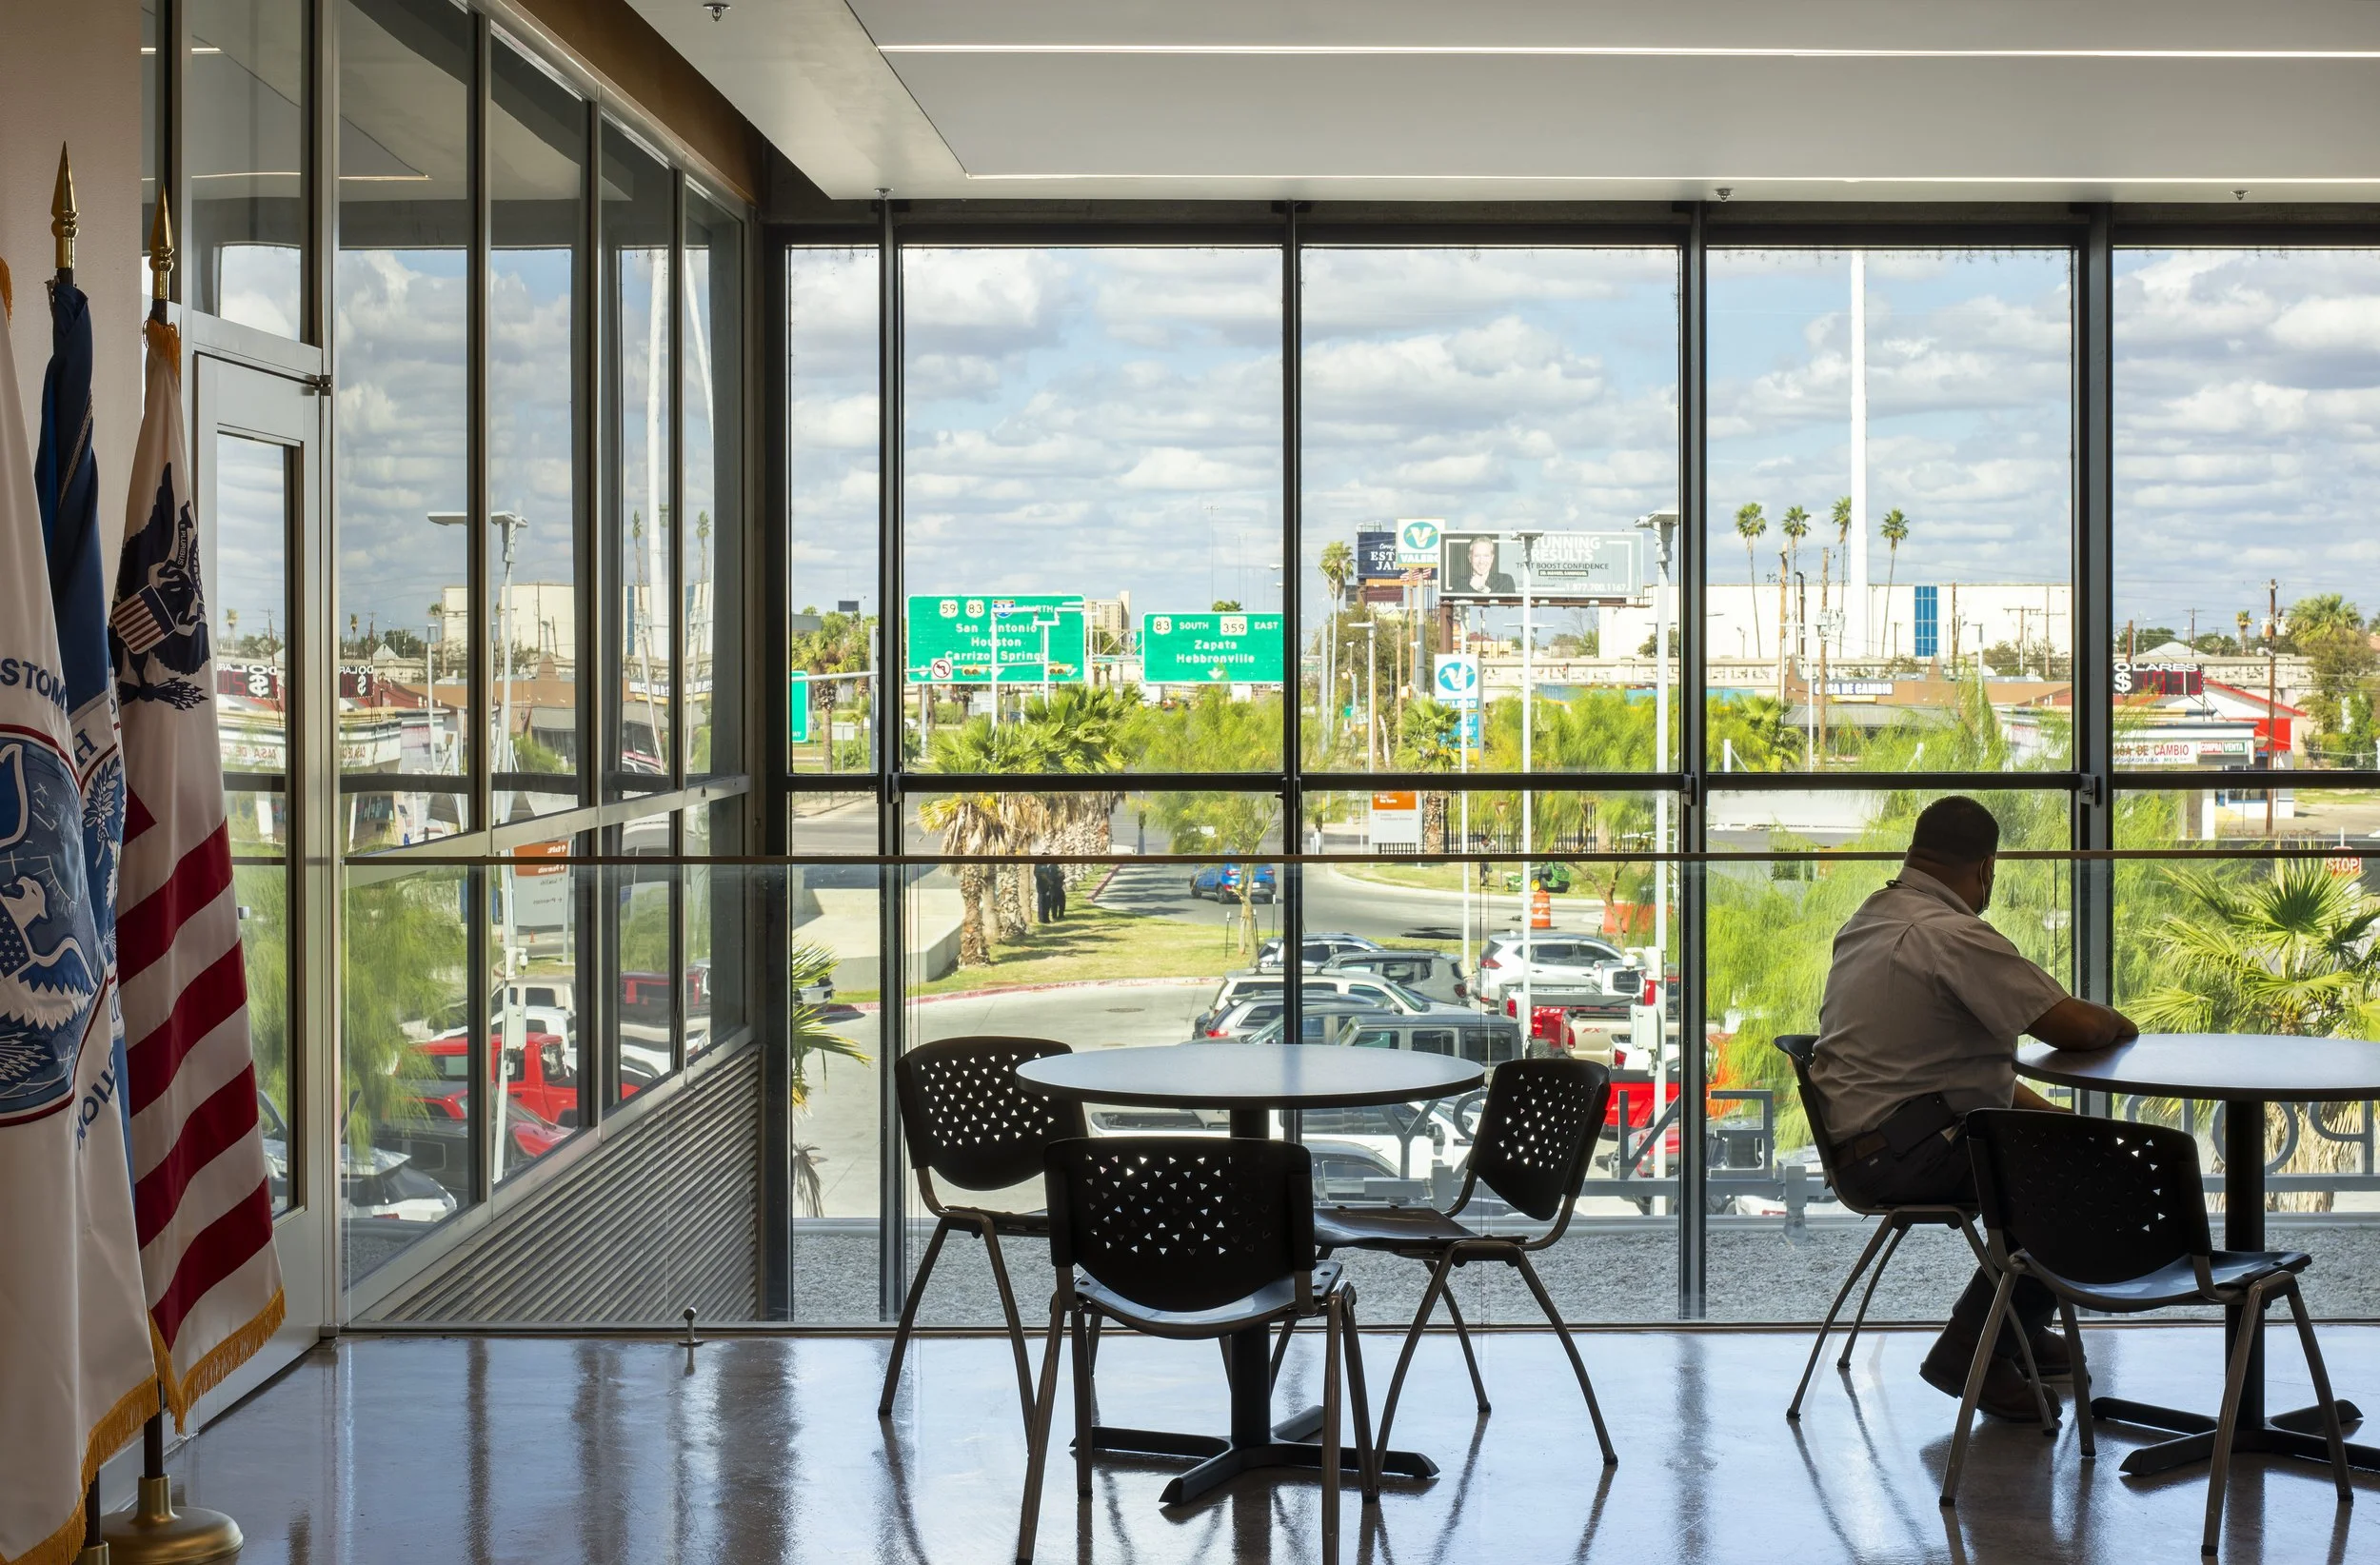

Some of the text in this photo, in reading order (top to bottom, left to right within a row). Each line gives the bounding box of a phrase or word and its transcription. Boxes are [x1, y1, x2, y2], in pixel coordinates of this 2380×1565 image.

[1533, 535, 1601, 550] TUNNING
[1370, 551, 1396, 562] EST
[1531, 548, 1594, 563] RESULTS
[1537, 562, 1561, 570] BOOST
[1563, 562, 1609, 570] CONFIDENCE
[942, 604, 956, 614] 59
[968, 604, 982, 614] 83
[1022, 604, 1054, 613] RTH
[956, 624, 978, 633] San
[1156, 621, 1169, 630] 83
[1180, 622, 1209, 630] SOUTH
[1222, 623, 1244, 633] 359
[971, 637, 1021, 647] Houston
[1194, 640, 1237, 651] Zapata
[945, 650, 1046, 663] Carrizo Springs
[1177, 654, 1255, 664] Hebbronville
[2113, 663, 2198, 672] OLARES
[1815, 683, 1893, 695] CSA DE CAMBIO
[1438, 700, 1477, 708] VLO
[2114, 744, 2189, 756] ASA DE CAMBIO
[2224, 743, 2242, 752] VENTA
[2328, 858, 2359, 871] STOP
